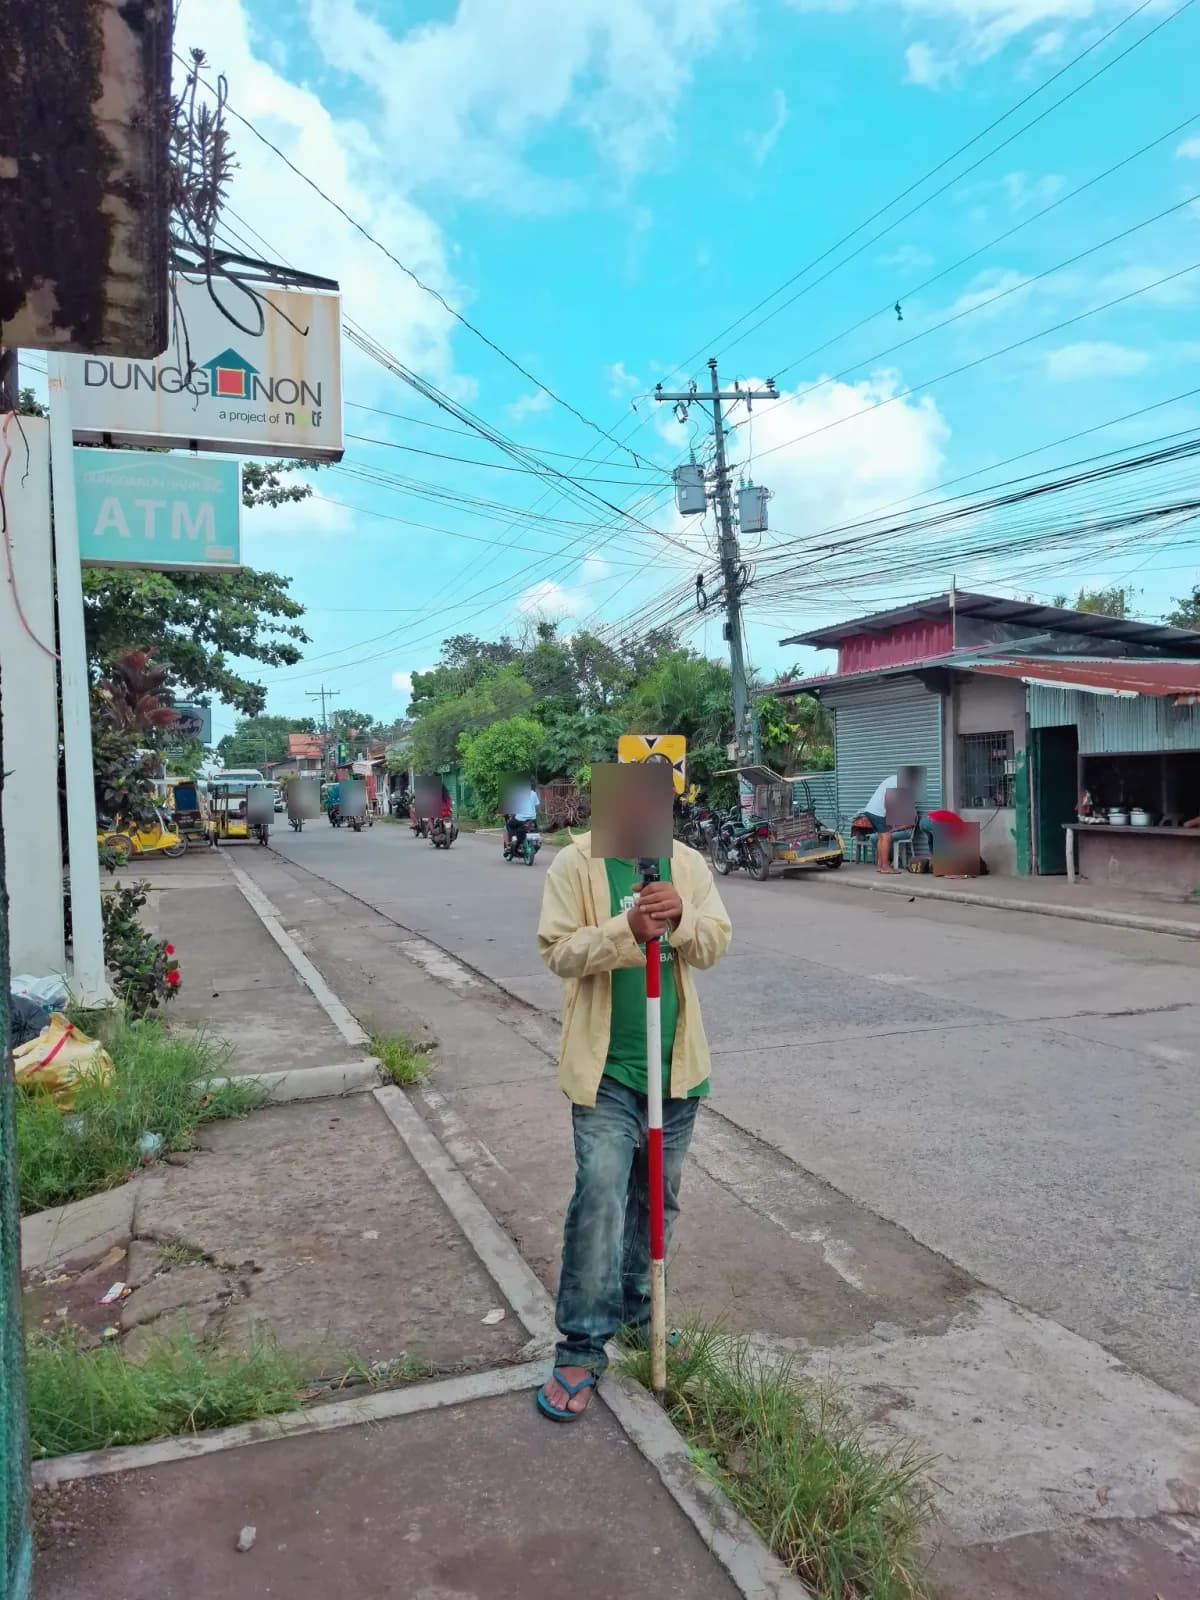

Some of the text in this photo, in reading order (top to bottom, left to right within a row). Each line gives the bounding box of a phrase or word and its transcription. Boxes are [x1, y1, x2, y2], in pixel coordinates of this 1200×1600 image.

[218, 410, 322, 428] a project of ntf
[93, 496, 216, 542] ATM
